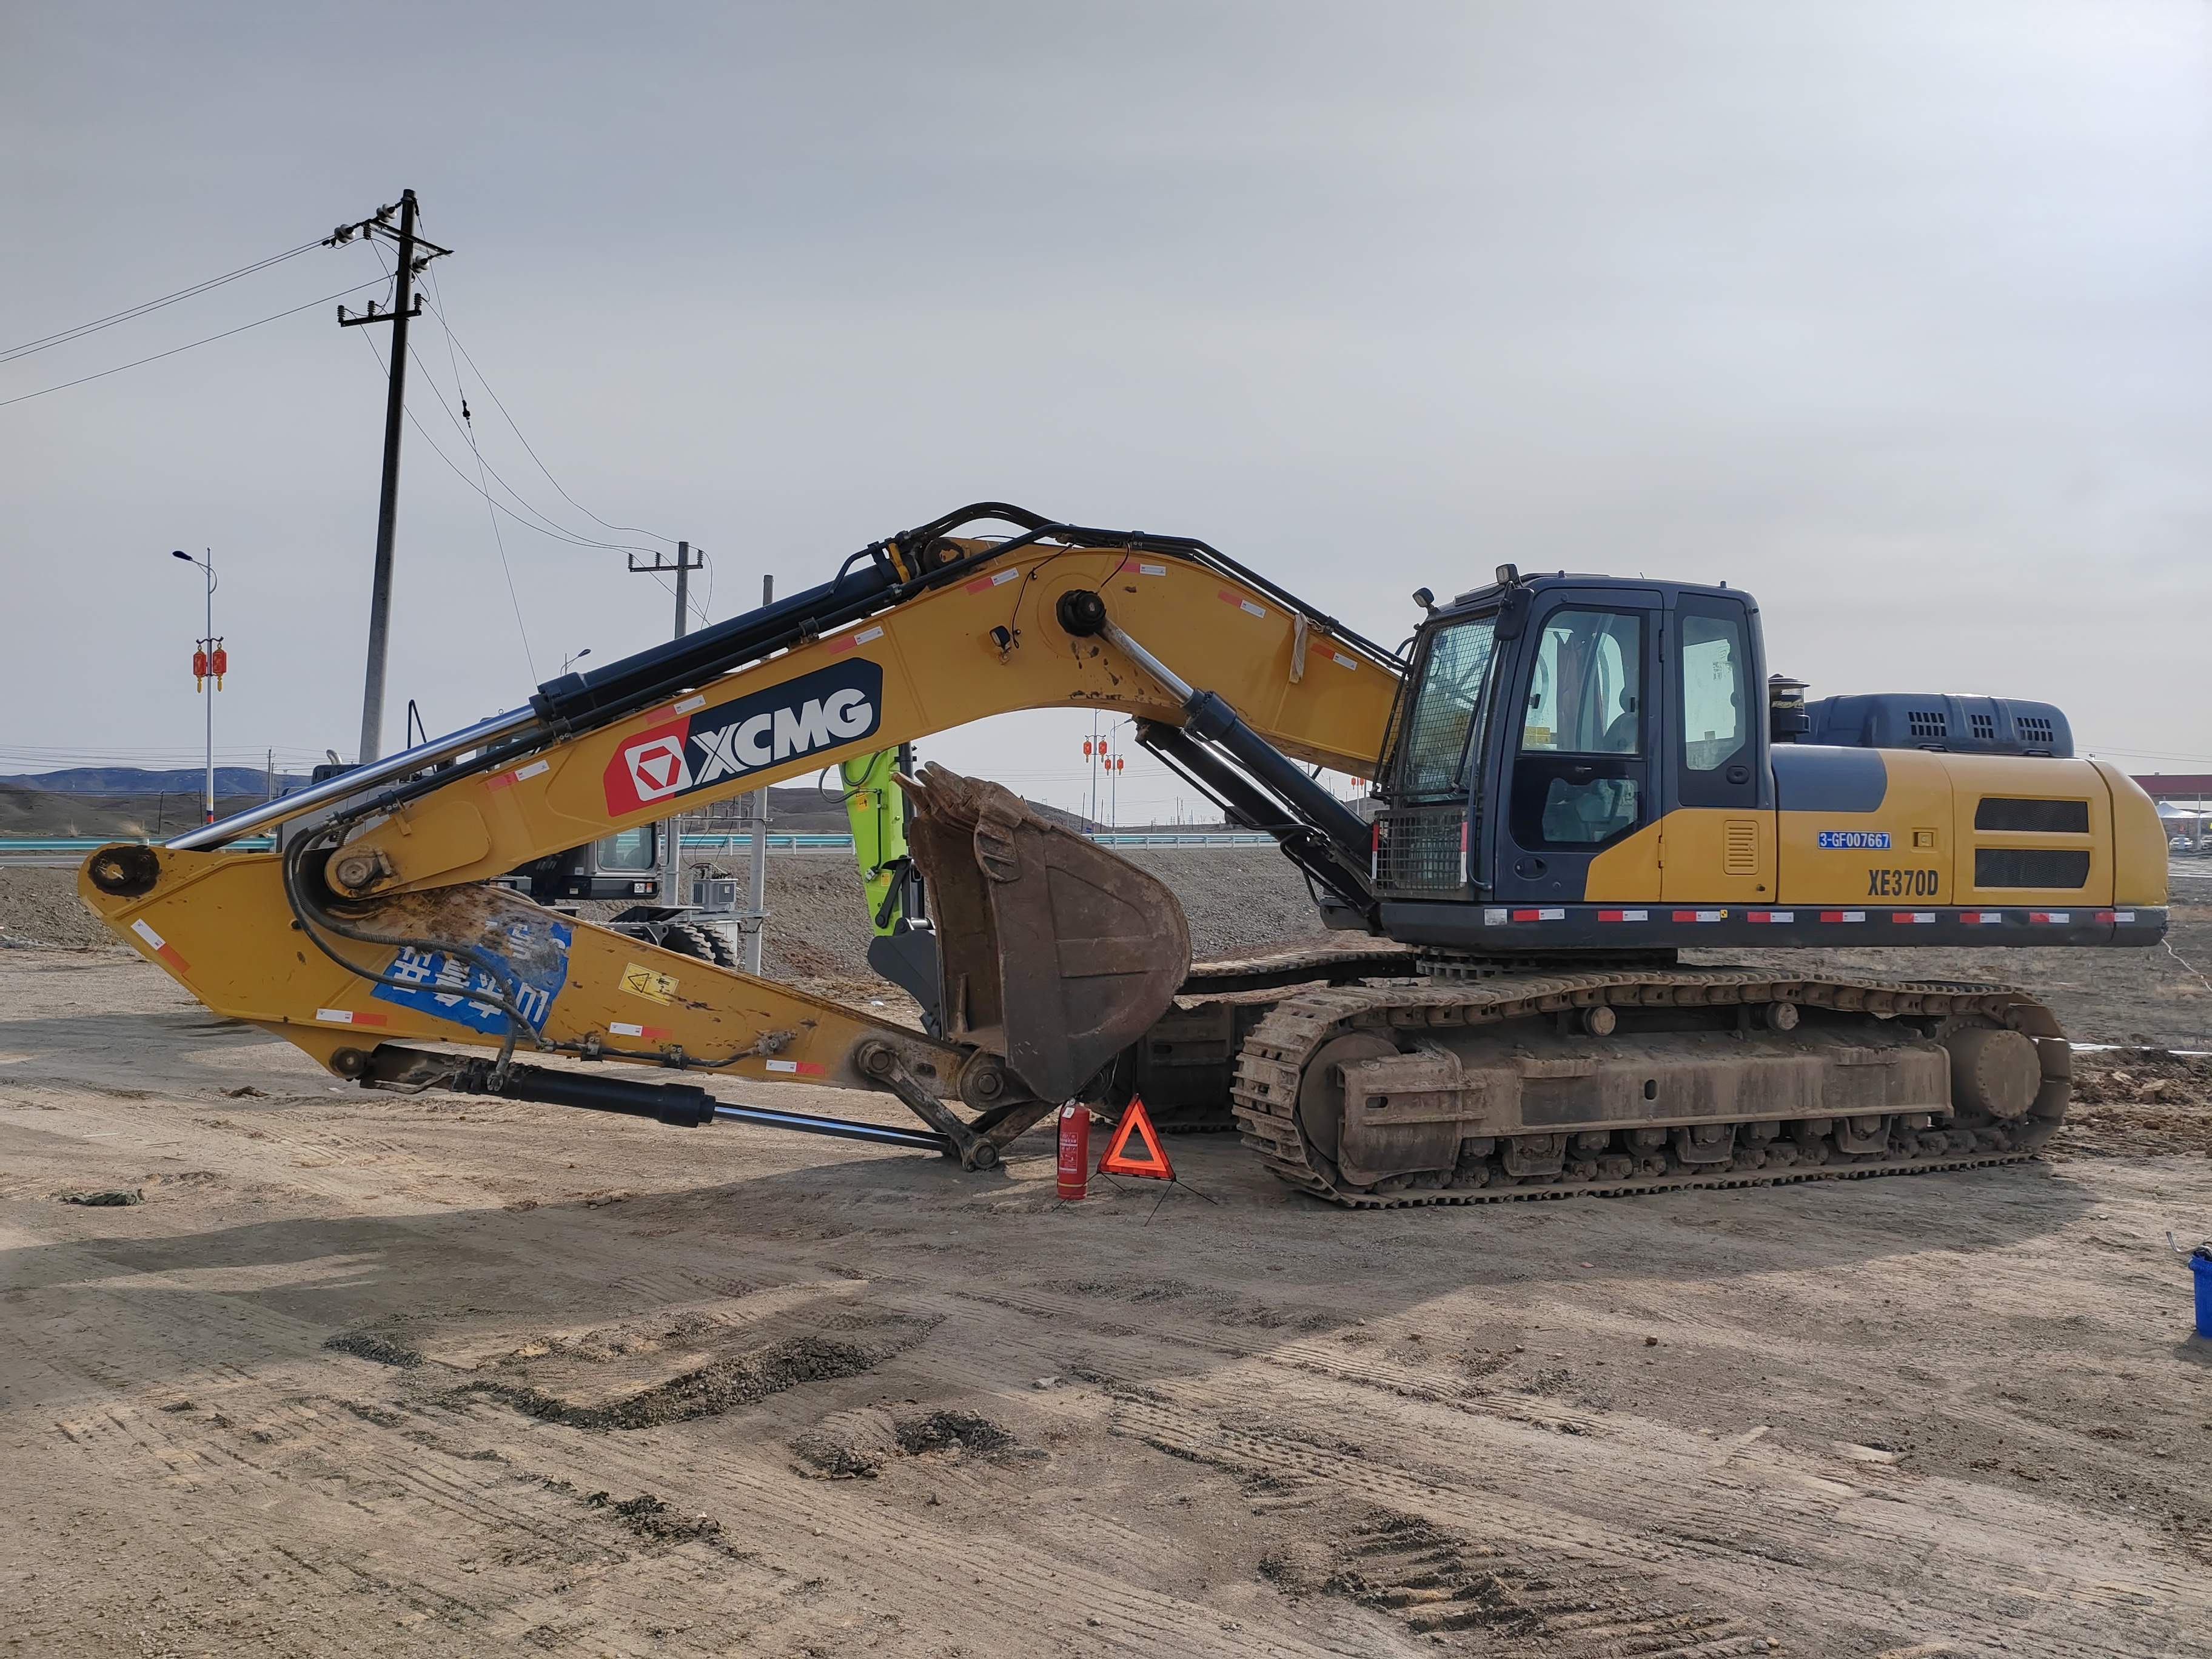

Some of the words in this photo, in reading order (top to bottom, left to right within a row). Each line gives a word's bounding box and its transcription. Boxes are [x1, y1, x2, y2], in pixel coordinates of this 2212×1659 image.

[691, 688, 873, 785] XCMG
[1820, 833, 1889, 848] 3-GF007667
[1868, 869, 1939, 896] XE370D
